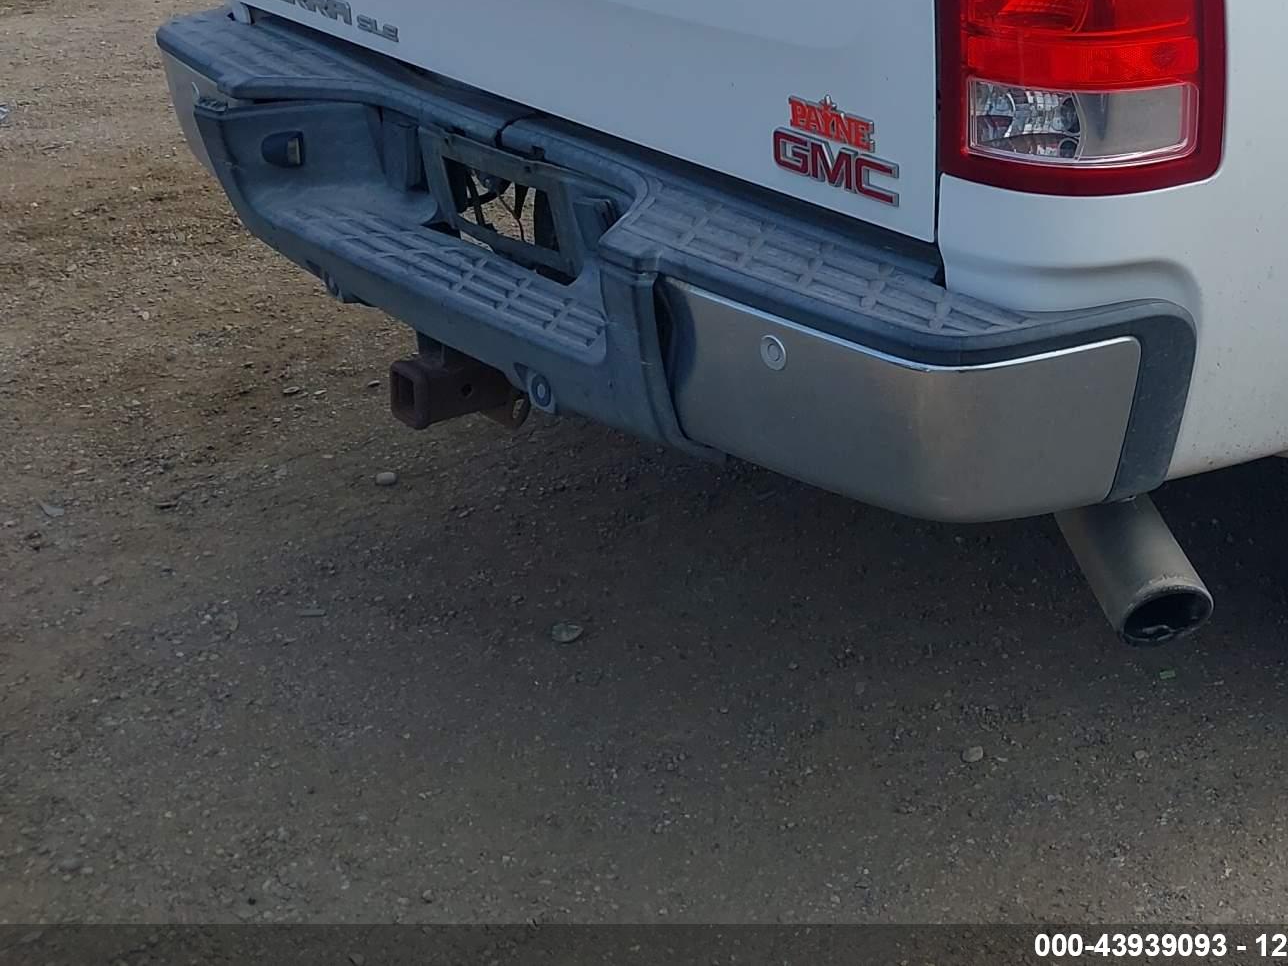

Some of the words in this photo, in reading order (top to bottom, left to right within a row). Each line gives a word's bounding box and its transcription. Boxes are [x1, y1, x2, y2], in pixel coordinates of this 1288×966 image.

[356, 14, 400, 43] SLE
[788, 95, 876, 153] PAYNE
[772, 126, 900, 208] GMC
